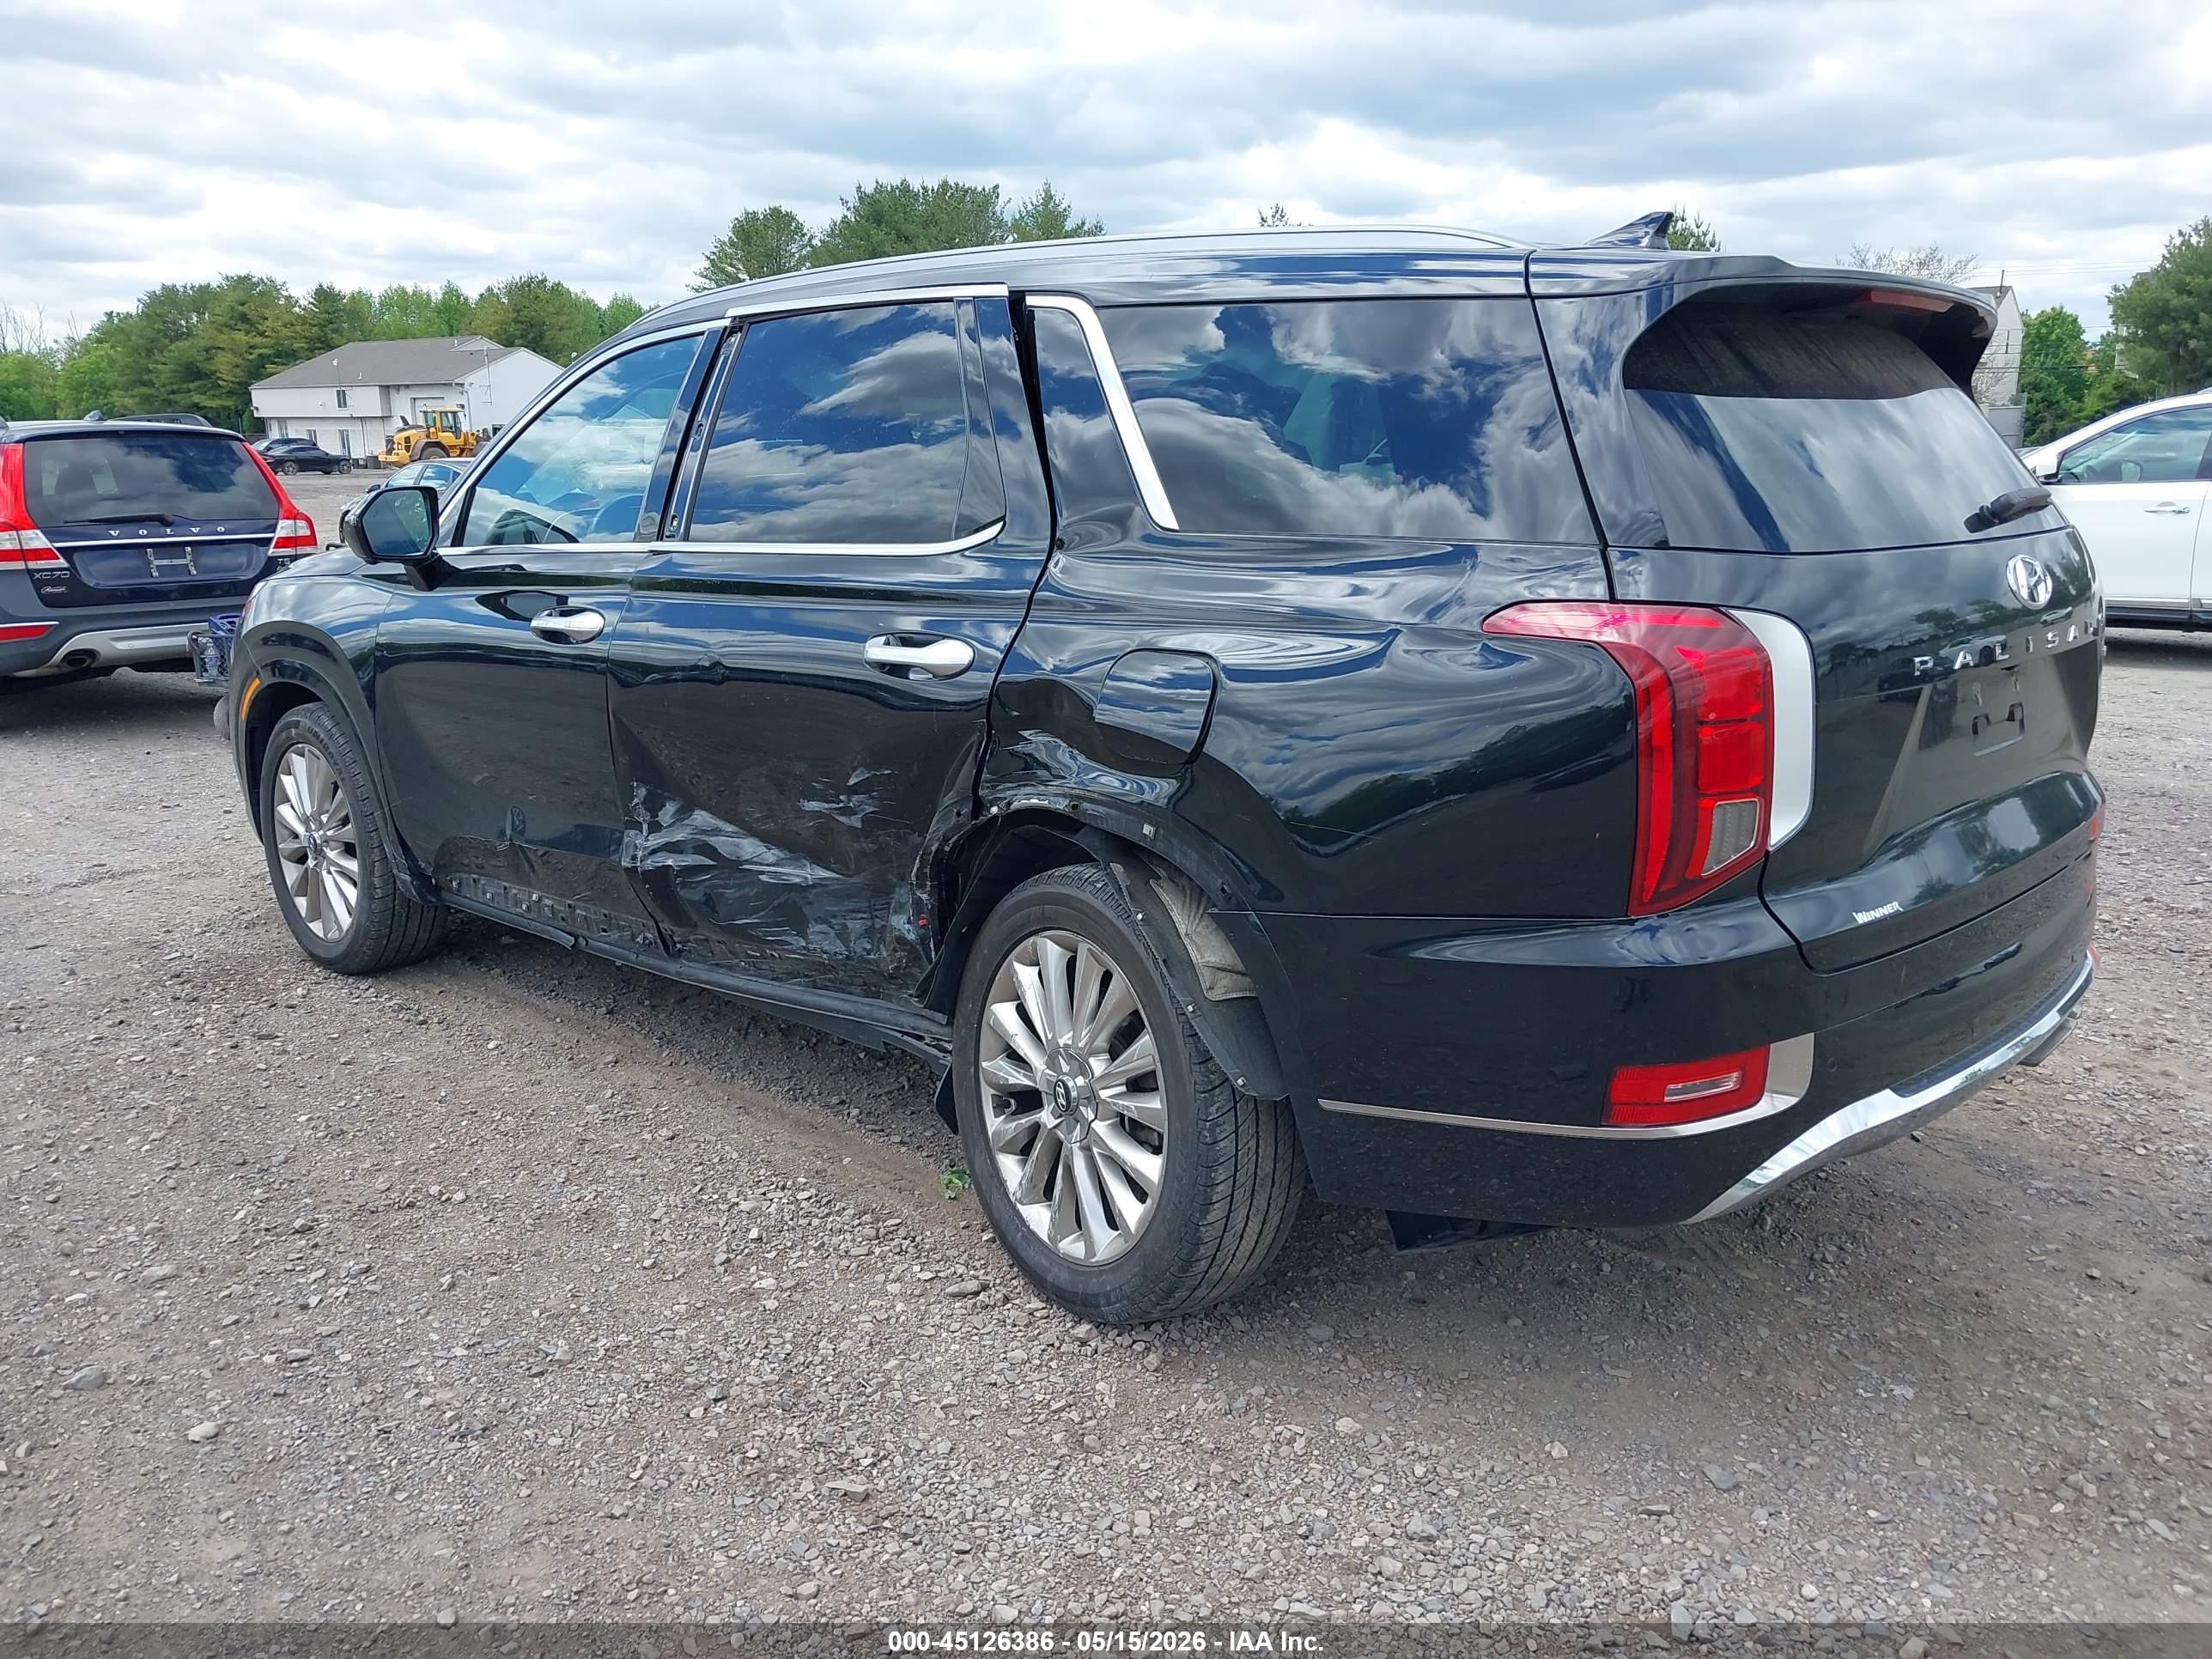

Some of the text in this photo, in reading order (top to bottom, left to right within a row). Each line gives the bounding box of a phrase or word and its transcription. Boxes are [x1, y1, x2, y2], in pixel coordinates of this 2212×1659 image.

[108, 526, 226, 537] VOLVO
[33, 570, 70, 580] XC70
[1851, 901, 1904, 925] WINNER
